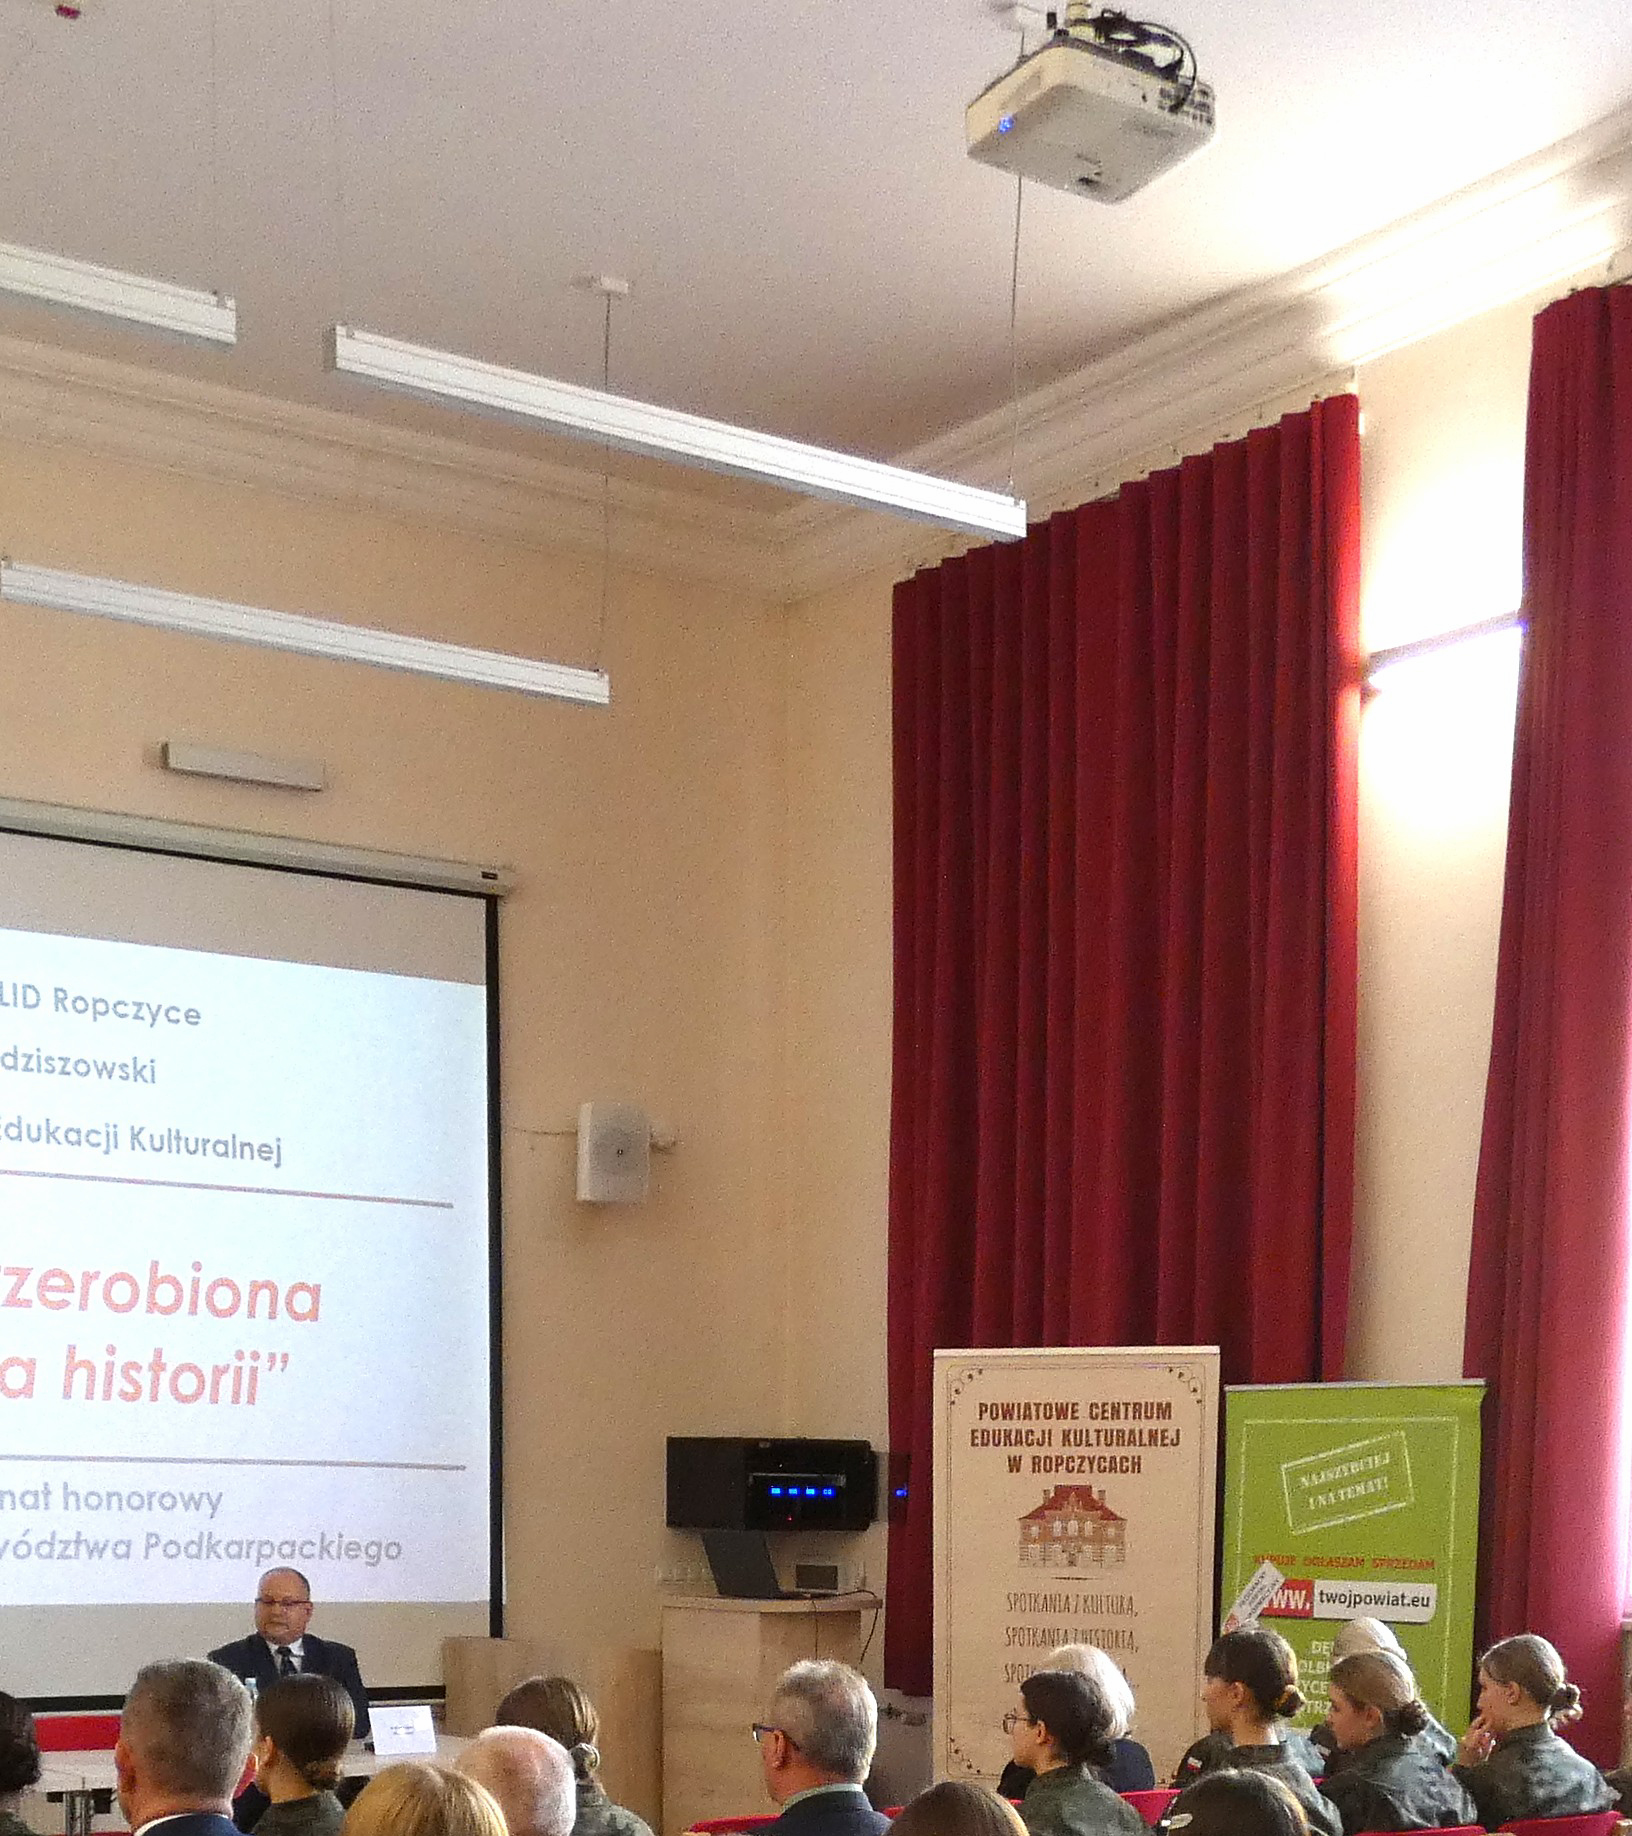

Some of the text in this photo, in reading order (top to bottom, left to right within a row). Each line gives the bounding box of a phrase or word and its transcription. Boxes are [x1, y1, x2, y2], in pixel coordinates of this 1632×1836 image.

[53, 986, 202, 1028] Ropczyce
[130, 1124, 282, 1169] Kulturalnej
[978, 1402, 1173, 1421] POWIATOWE CENTRUM
[970, 1428, 1181, 1447] EDUKACJI KULTURALNEJ
[1007, 1455, 1142, 1474] W ROPCZYCACH
[63, 1481, 224, 1519] honorowy
[144, 1531, 403, 1568] Podkarpackiego
[1006, 1592, 1070, 1613] SPOTKANIA
[1265, 1589, 1430, 1610] WW. twojpowiat.eu
[1005, 1626, 1069, 1649] SPOTKANIA
